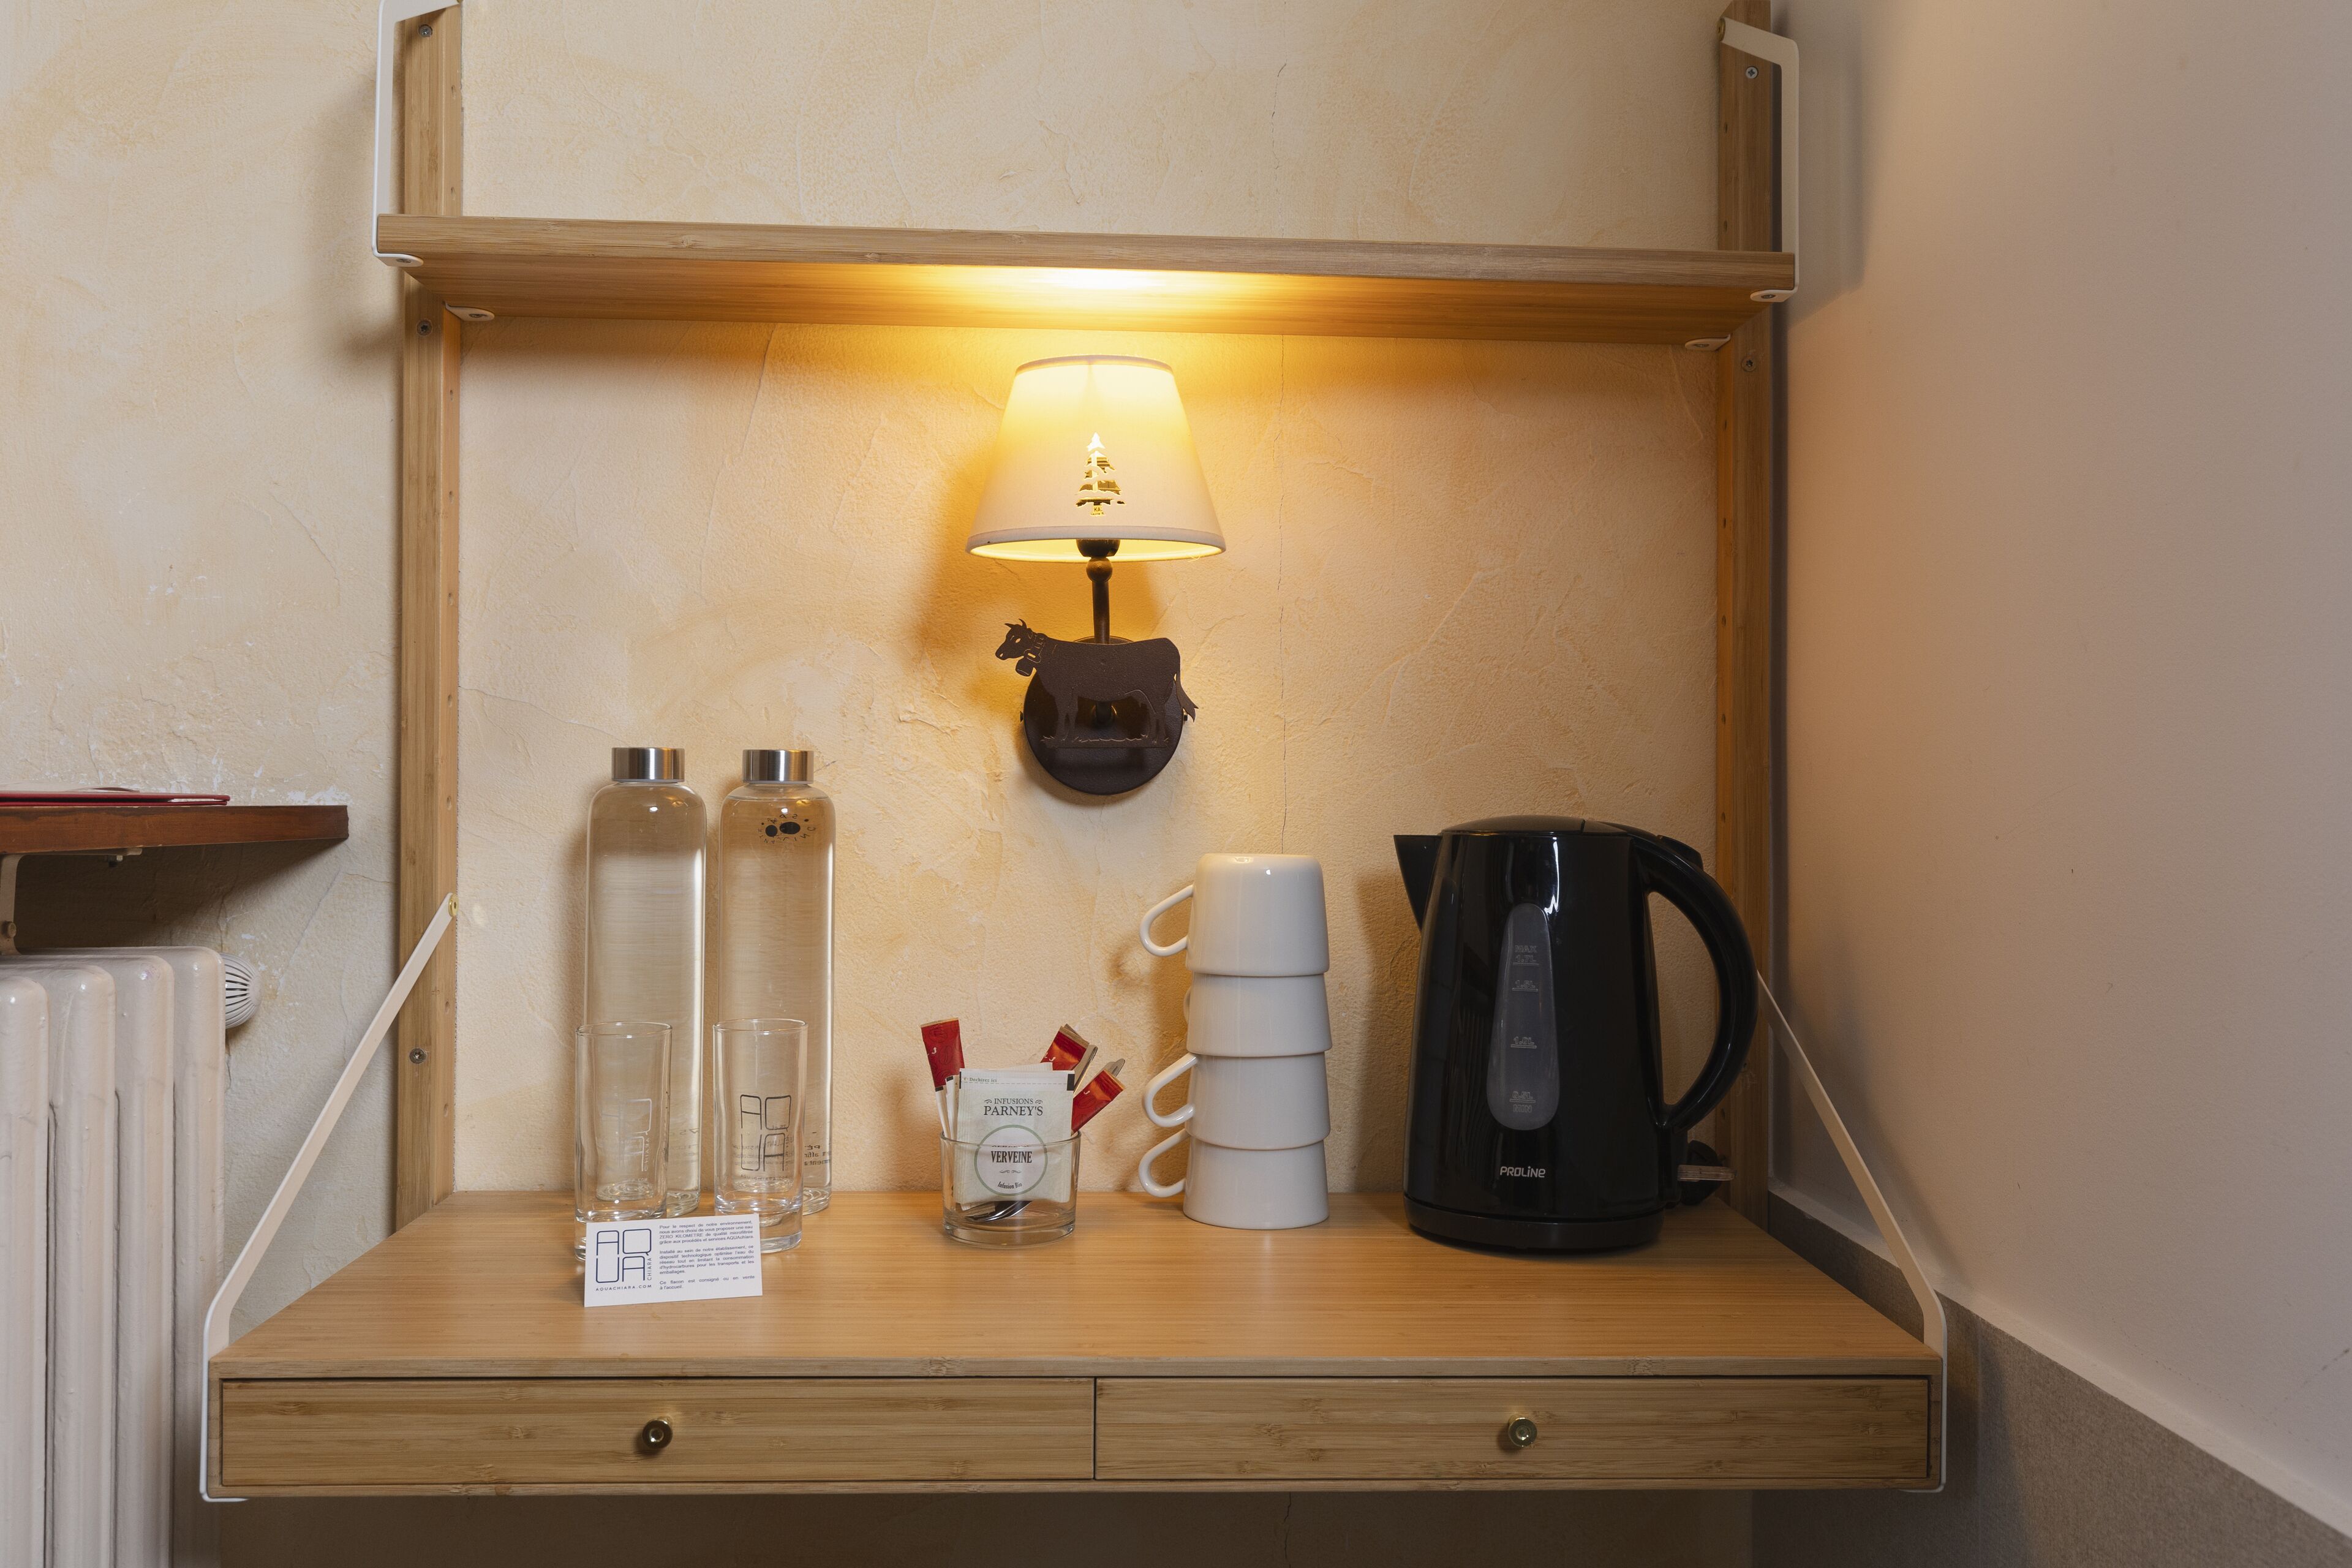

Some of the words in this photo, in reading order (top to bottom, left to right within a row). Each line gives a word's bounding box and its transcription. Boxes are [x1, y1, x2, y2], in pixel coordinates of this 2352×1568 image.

[1515, 980, 1536, 989] 1.5L
[1513, 1036, 1534, 1045] 1.0L
[984, 1106, 1043, 1116] PARNEY'S
[991, 1152, 1032, 1163] VERVEINE
